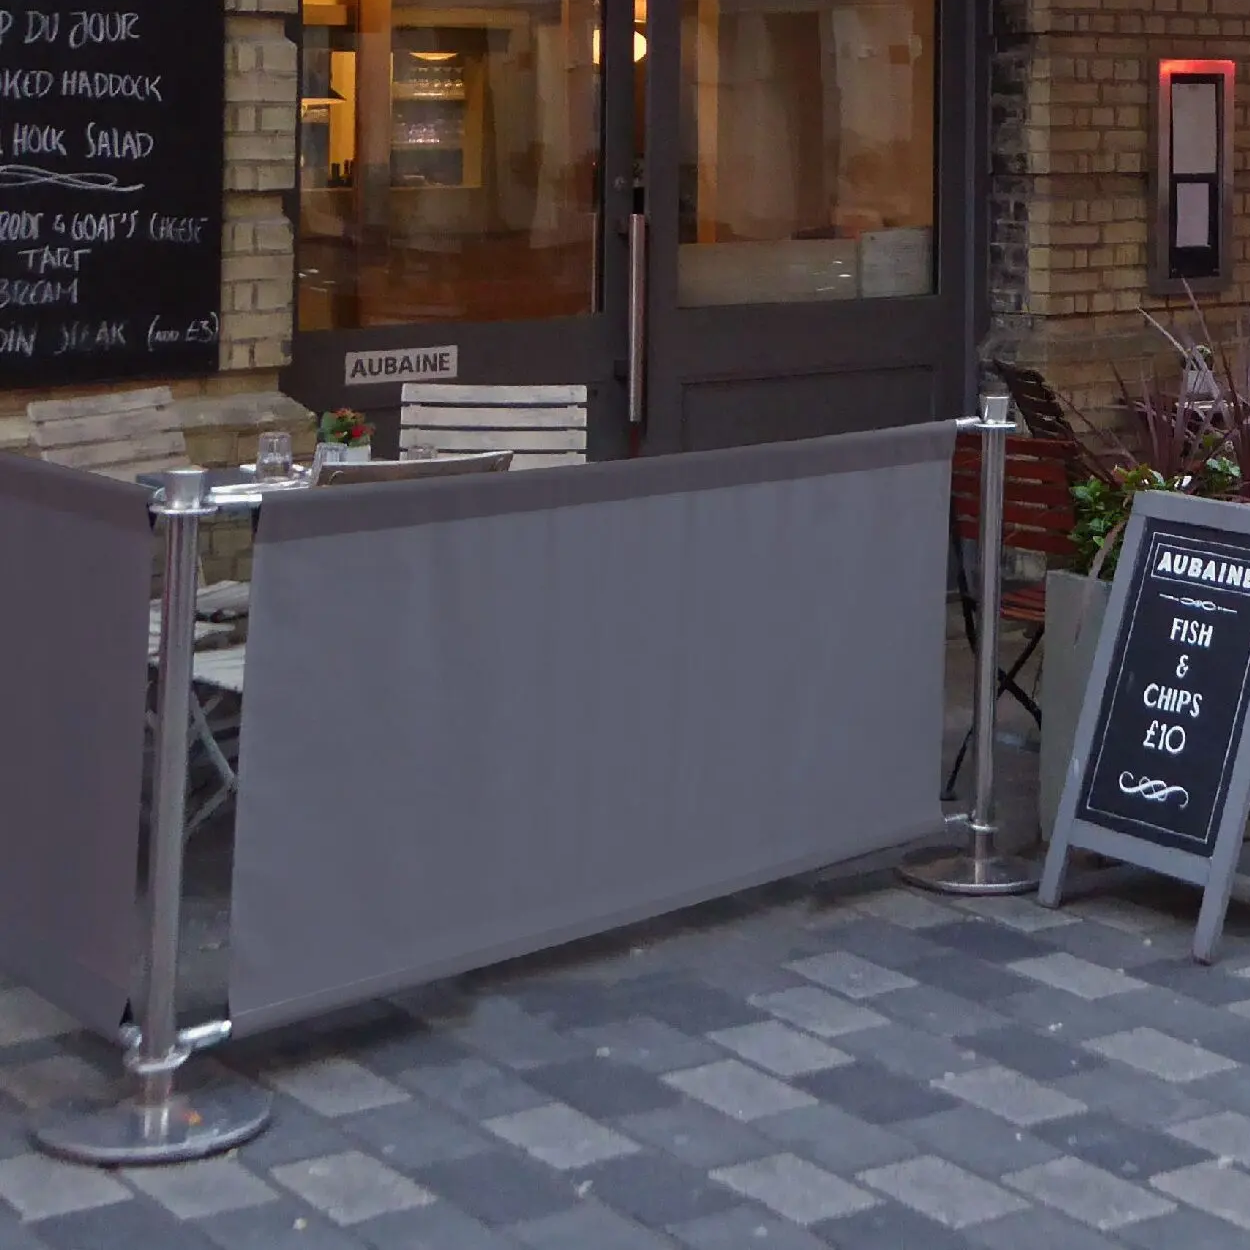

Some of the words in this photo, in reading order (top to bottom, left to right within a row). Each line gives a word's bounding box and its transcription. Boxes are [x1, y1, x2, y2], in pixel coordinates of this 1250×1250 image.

[24, 11, 60, 44] DU
[69, 11, 140, 49] JOUR
[0, 69, 54, 99] KED
[61, 70, 163, 101] HADDOCK
[13, 123, 67, 157] HOCK
[86, 122, 154, 159] SALAD
[71, 210, 139, 241] GOAT'S
[18, 244, 92, 274] TART
[351, 352, 450, 378] AUBAINE
[1170, 617, 1214, 648] FISH
[1176, 654, 1189, 678] &
[1143, 683, 1203, 718] CHIPS
[1143, 720, 1186, 754] £10
